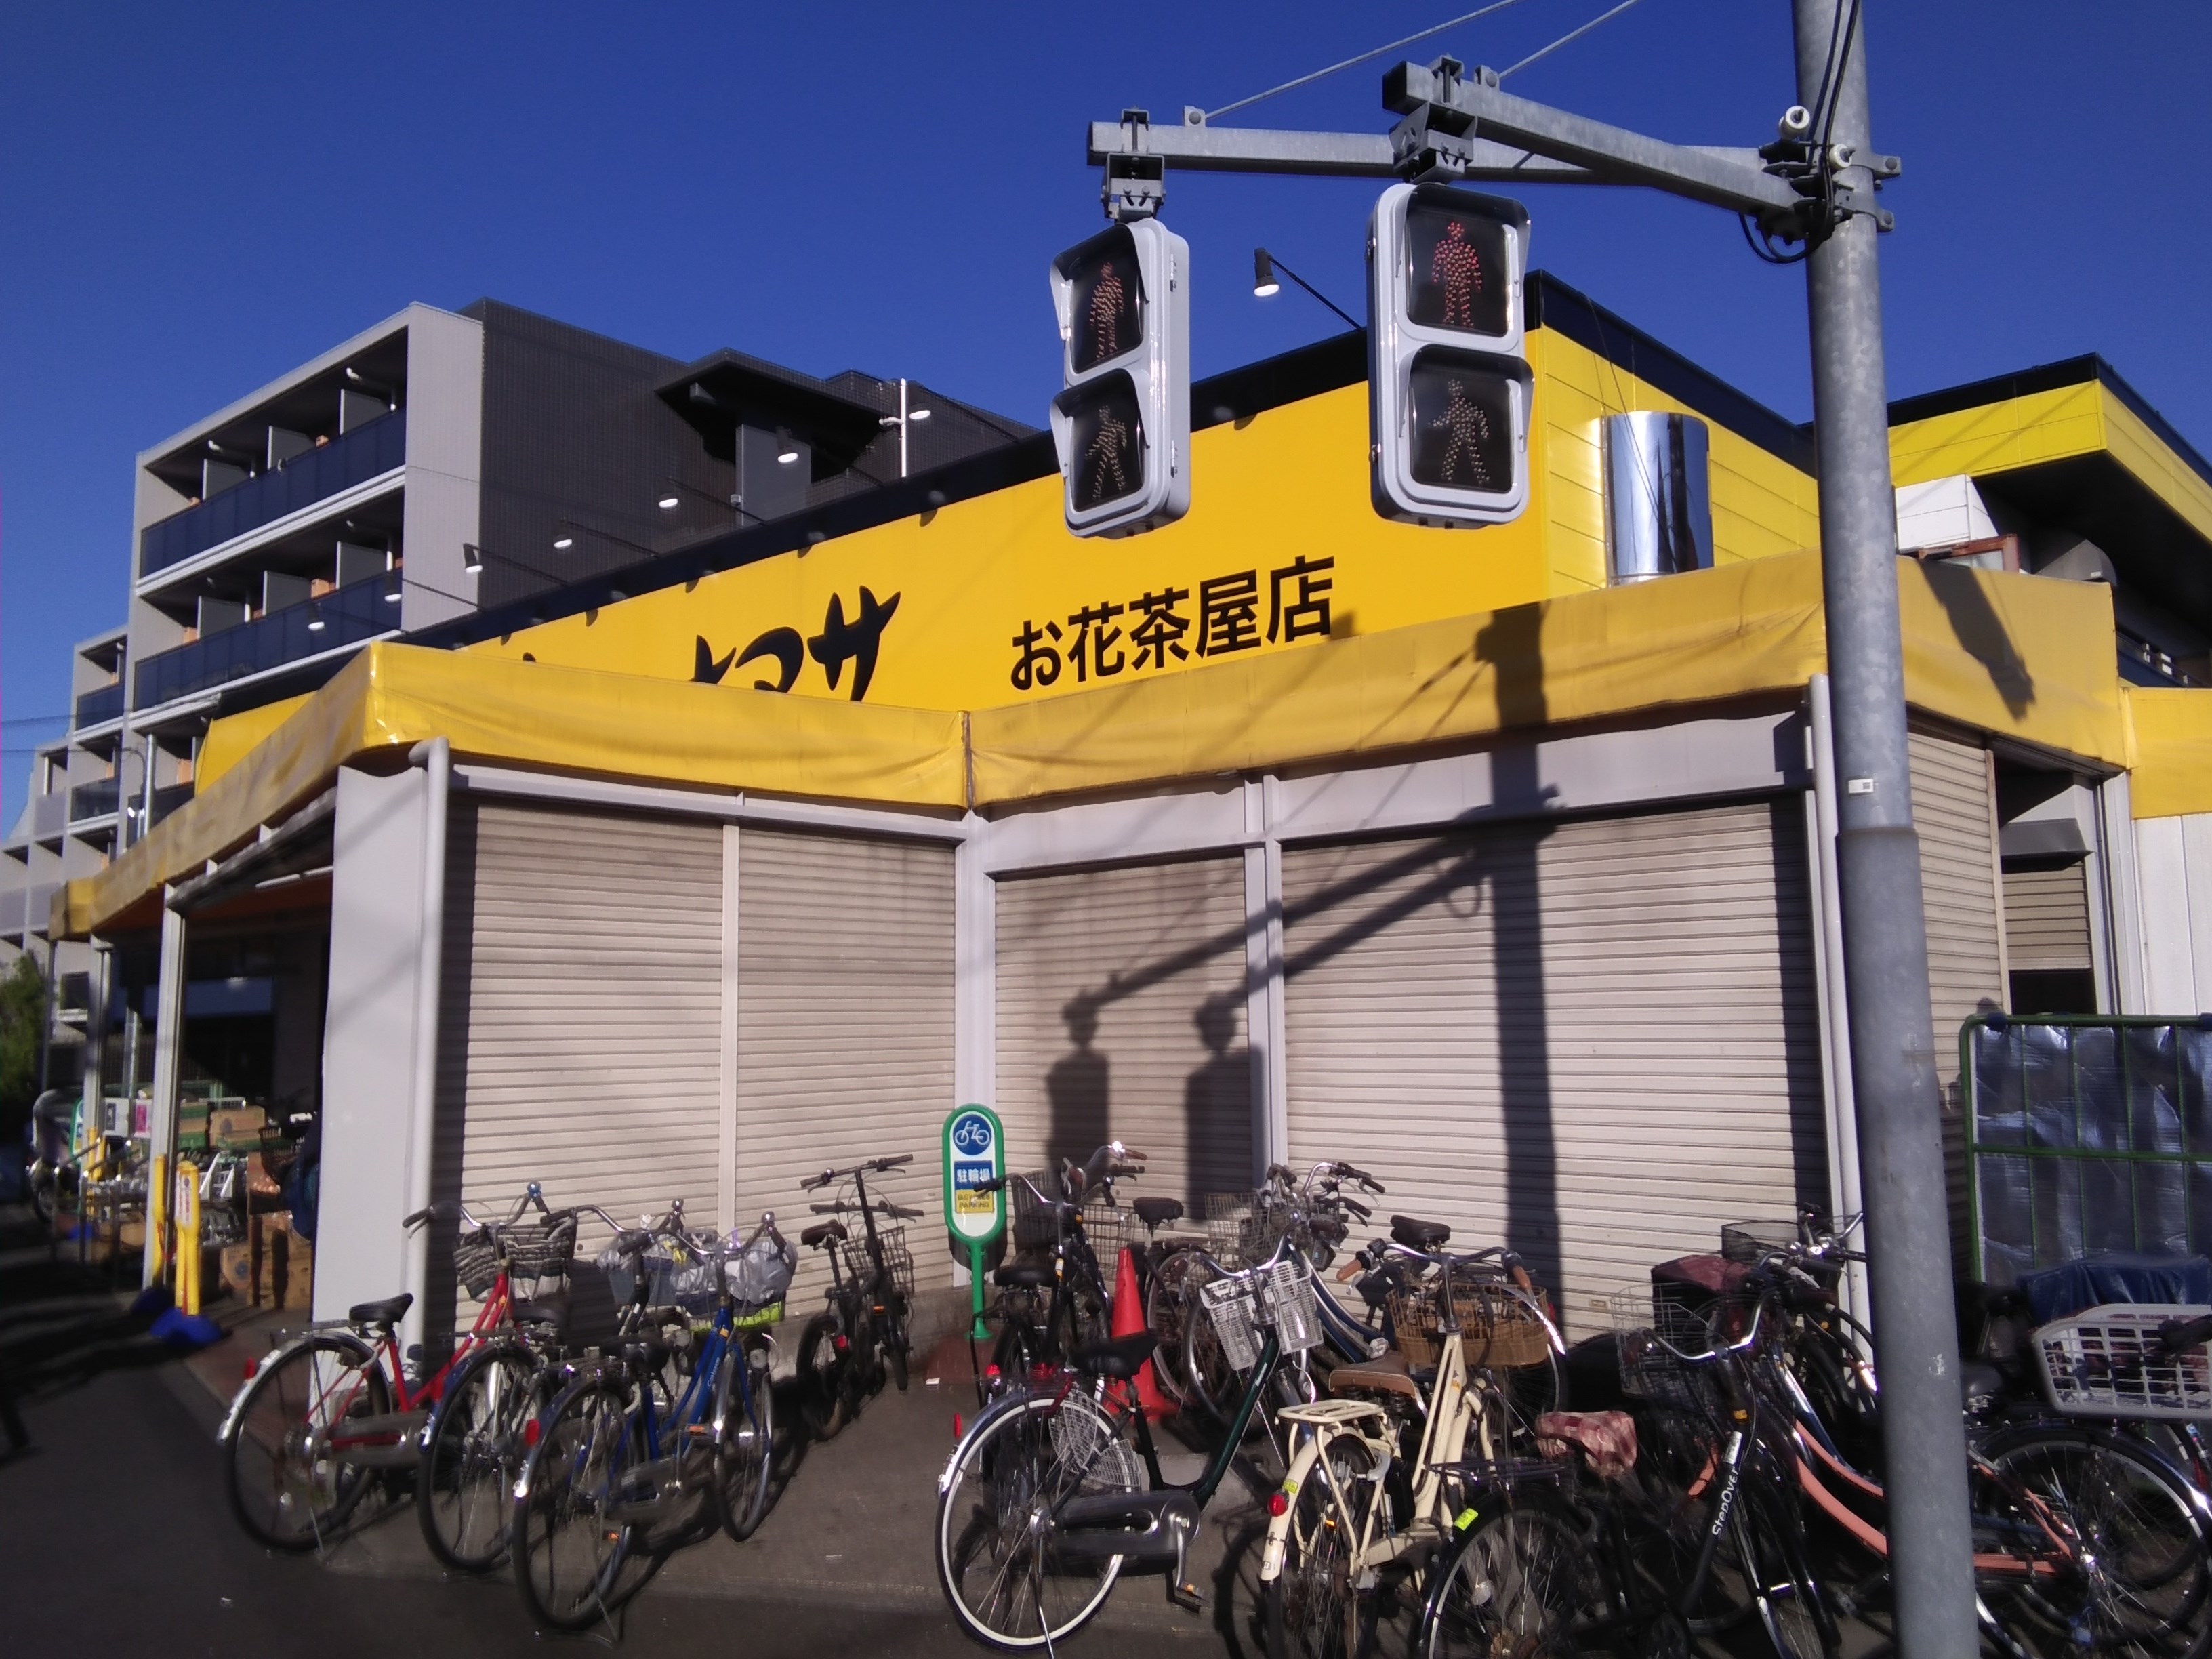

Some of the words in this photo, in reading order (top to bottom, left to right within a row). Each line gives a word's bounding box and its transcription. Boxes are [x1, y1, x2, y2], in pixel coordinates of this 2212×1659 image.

[1010, 554, 1335, 691] お花茶屋店
[956, 1168, 990, 1183] 駐輪場
